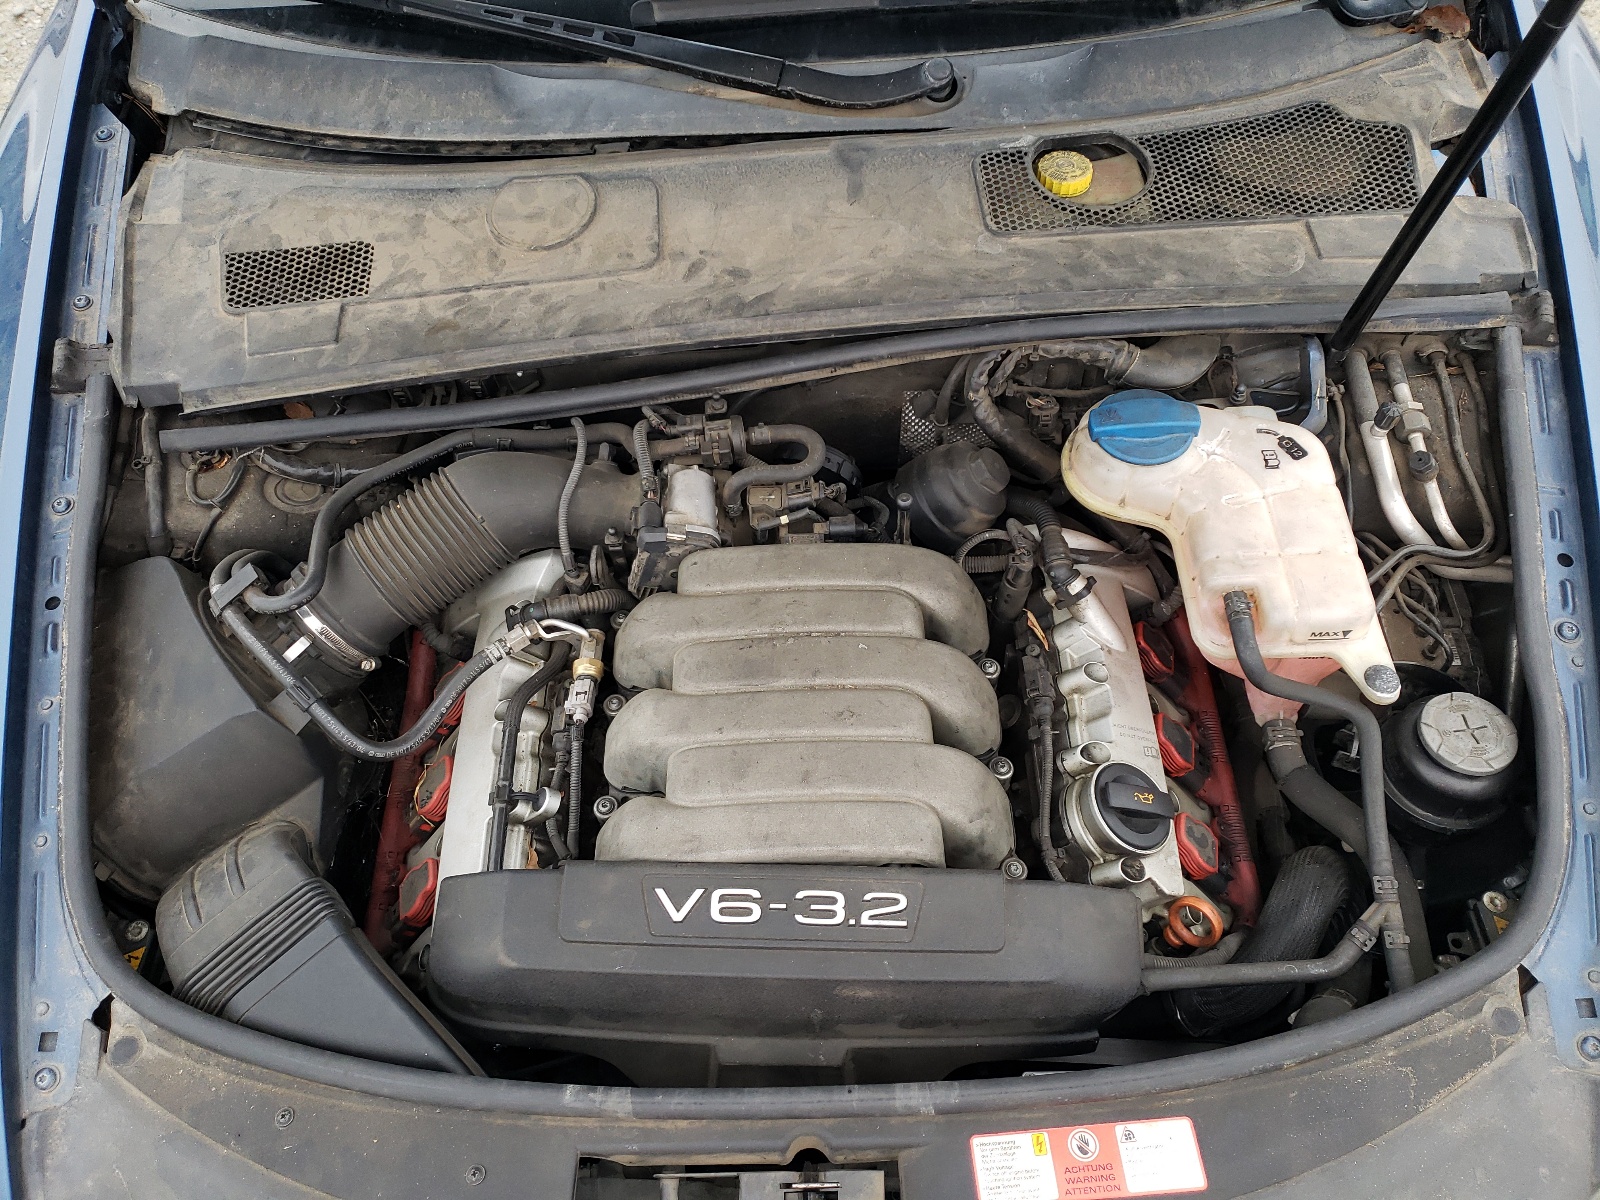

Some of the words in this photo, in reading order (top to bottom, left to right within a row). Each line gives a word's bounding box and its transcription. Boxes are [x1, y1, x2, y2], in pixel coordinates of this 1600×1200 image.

[654, 887, 908, 928] V6-3.2
[1064, 1163, 1113, 1174] ACHTUNG
[1065, 1173, 1116, 1185] WARNING
[1065, 1184, 1121, 1196] ATTENTION
